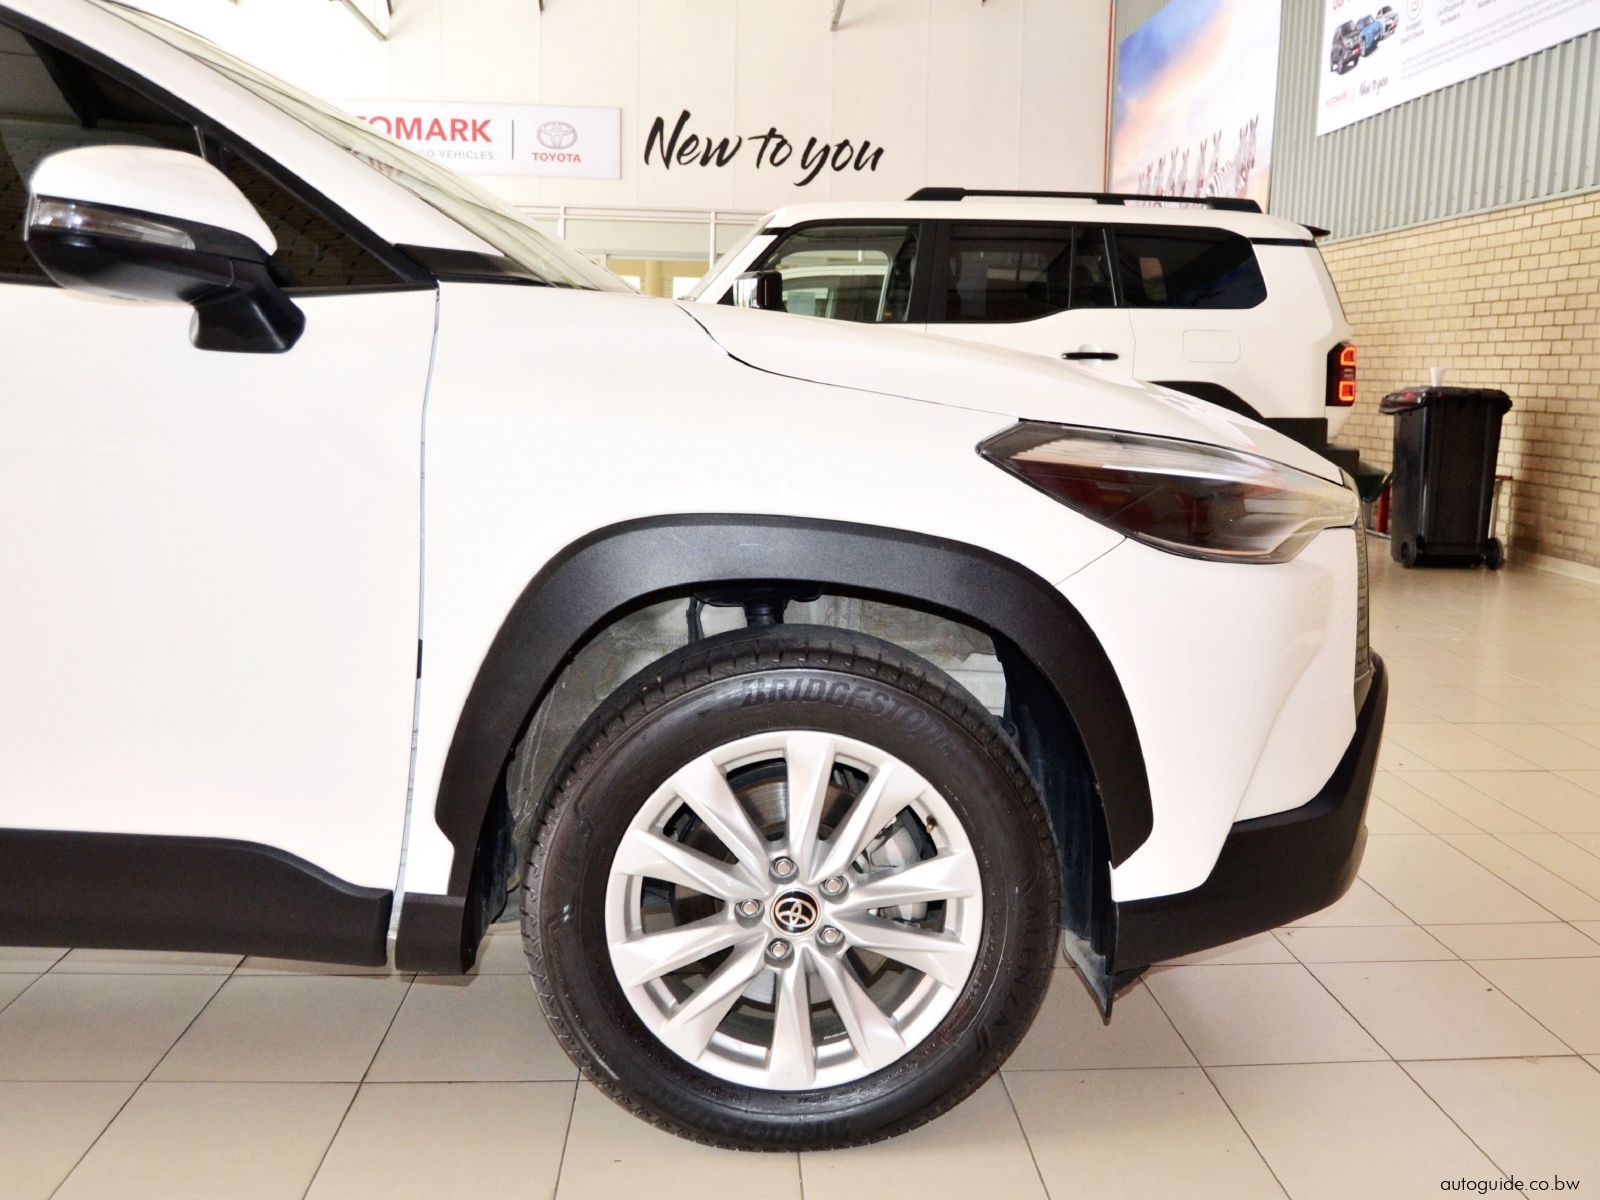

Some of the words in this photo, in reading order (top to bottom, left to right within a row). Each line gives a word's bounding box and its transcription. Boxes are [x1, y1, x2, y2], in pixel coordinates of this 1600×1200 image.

[357, 115, 493, 143] OMARK
[439, 150, 494, 161] VEHICLES
[532, 151, 581, 163] TOYOTA
[644, 109, 743, 170] New
[747, 127, 793, 169] to
[793, 136, 884, 187] you
[741, 676, 950, 752] BRIDGESTO
